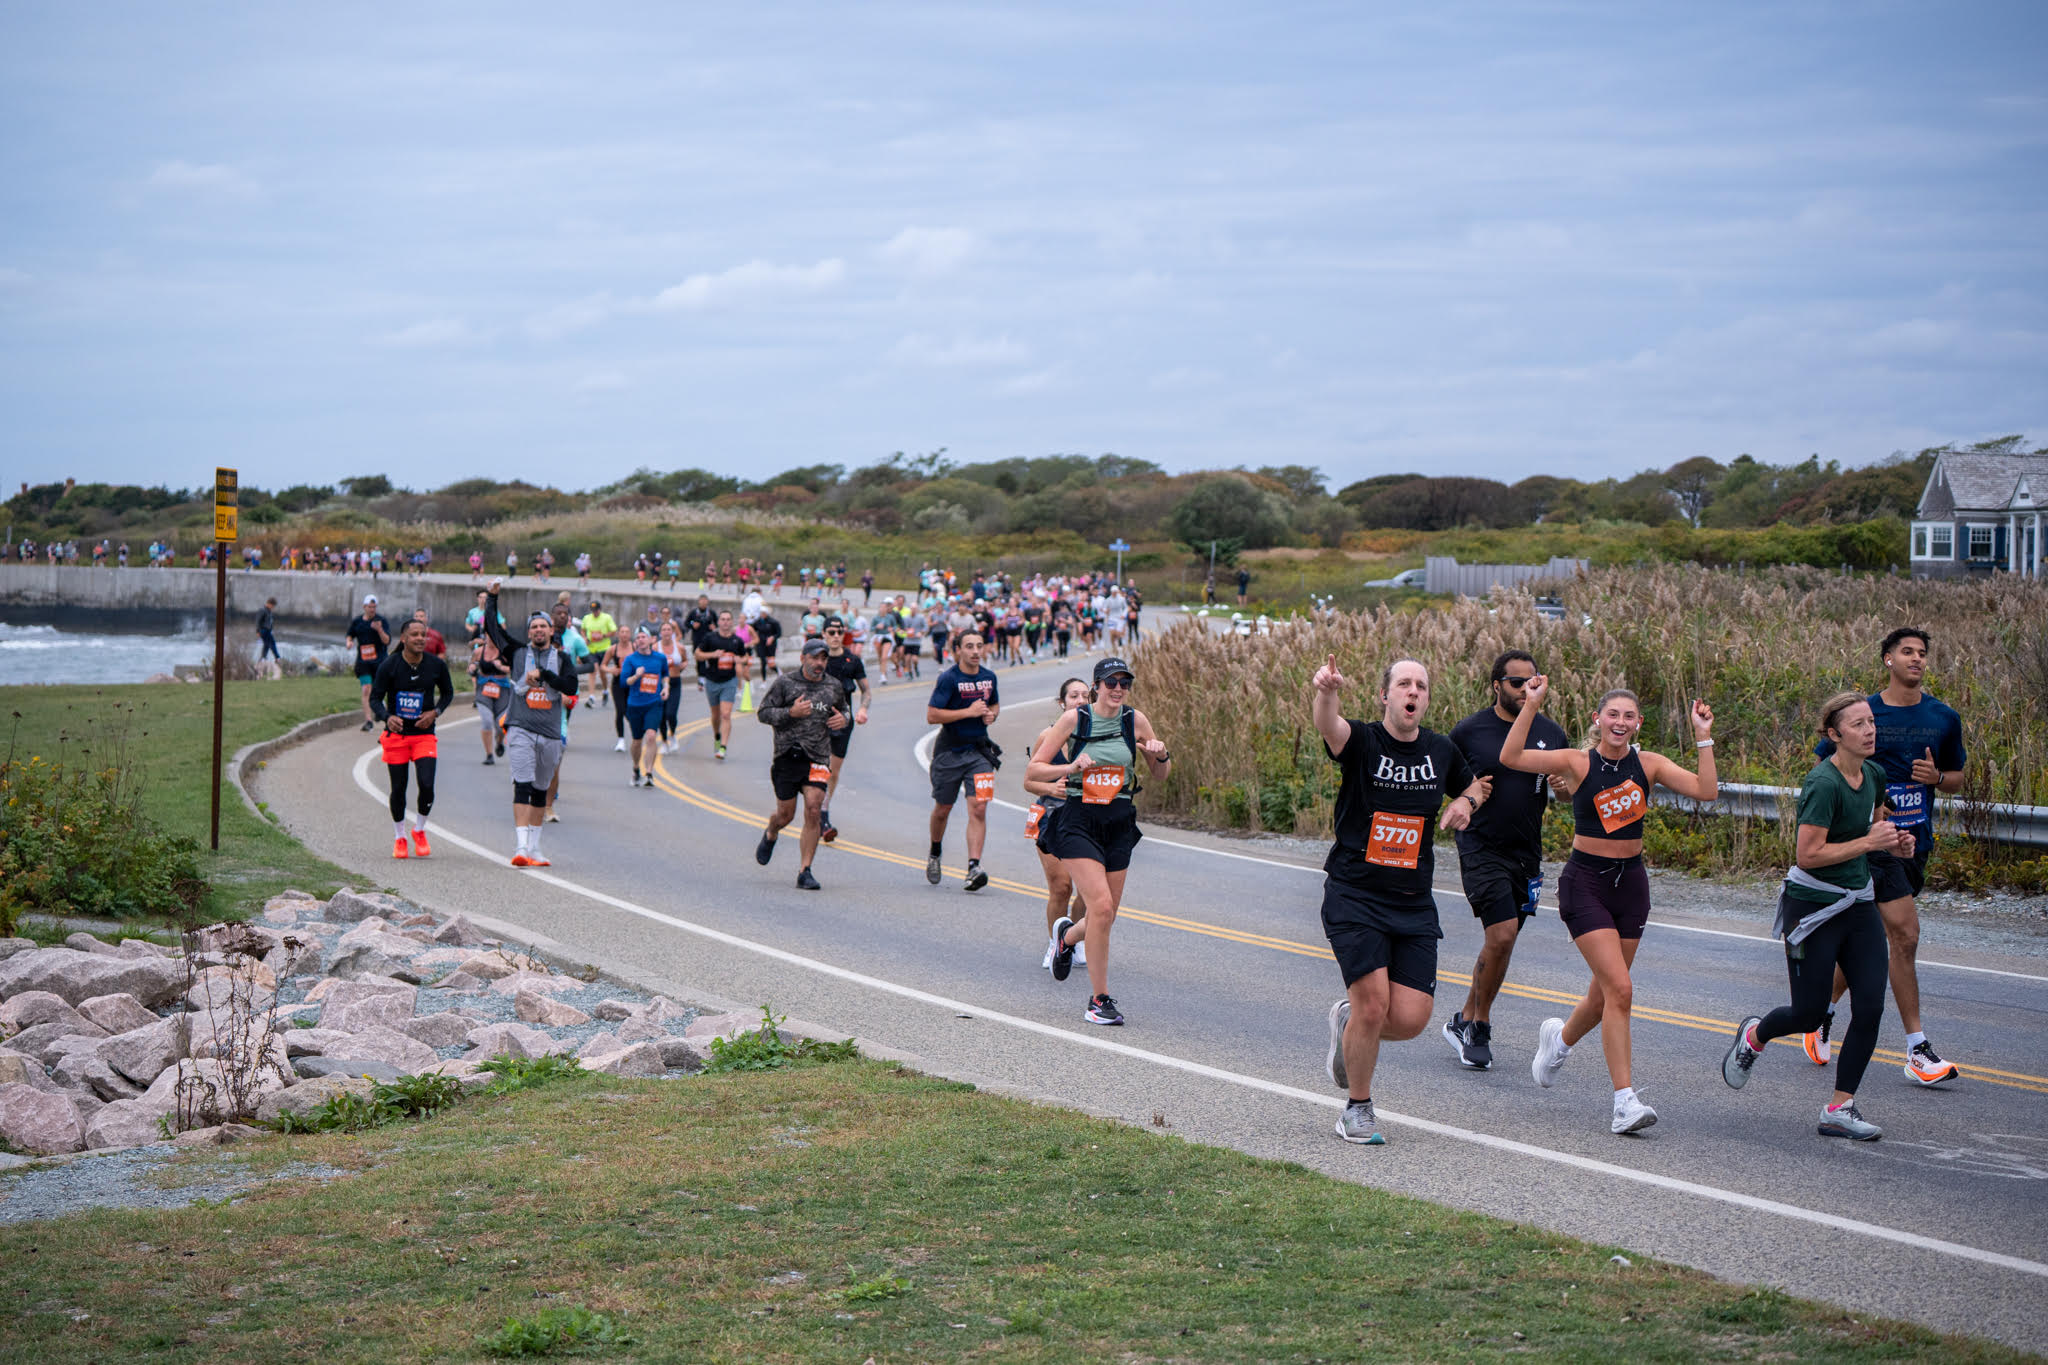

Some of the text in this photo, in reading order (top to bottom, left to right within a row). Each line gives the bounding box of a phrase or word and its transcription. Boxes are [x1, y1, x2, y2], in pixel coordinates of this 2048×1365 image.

[958, 680, 993, 692] RED SOX
[399, 697, 420, 708] 1124
[527, 692, 549, 702] 427
[1373, 754, 1438, 783] Bard
[1086, 773, 1121, 787] 4136
[1373, 780, 1400, 790] CROSS
[1599, 789, 1641, 819] 3399
[1891, 792, 1922, 808] 1128
[1373, 825, 1419, 845] 3770
[1381, 846, 1406, 854] ROBERT
